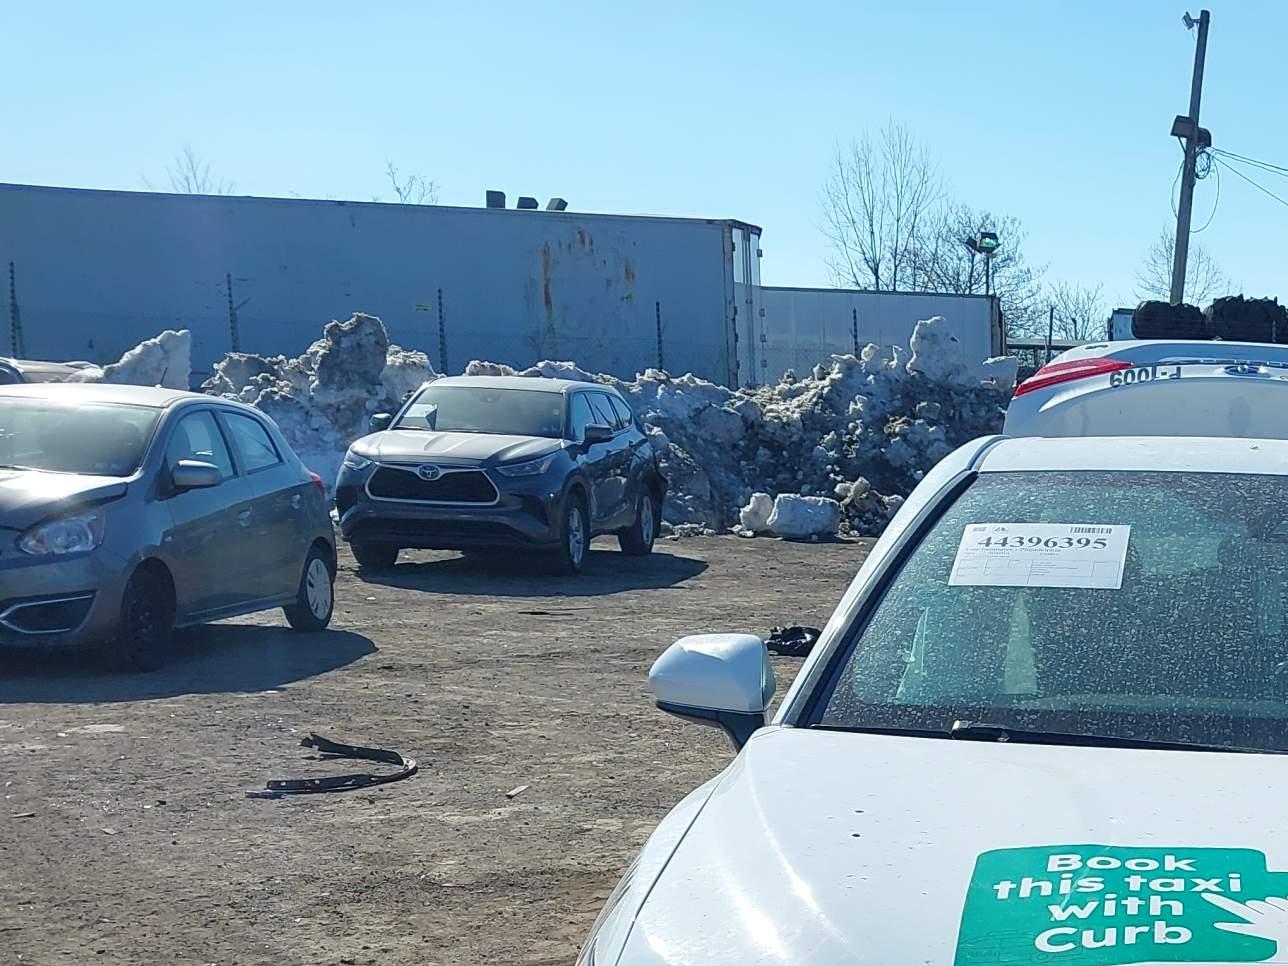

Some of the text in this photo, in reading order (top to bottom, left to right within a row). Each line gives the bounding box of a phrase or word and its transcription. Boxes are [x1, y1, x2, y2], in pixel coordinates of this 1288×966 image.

[1110, 367, 1181, 389] P-1009
[977, 536, 1108, 550] 44396395
[1047, 853, 1197, 872] Book
[992, 873, 1241, 899] this taxi
[1048, 893, 1184, 921] with
[1034, 920, 1193, 953] Curb
